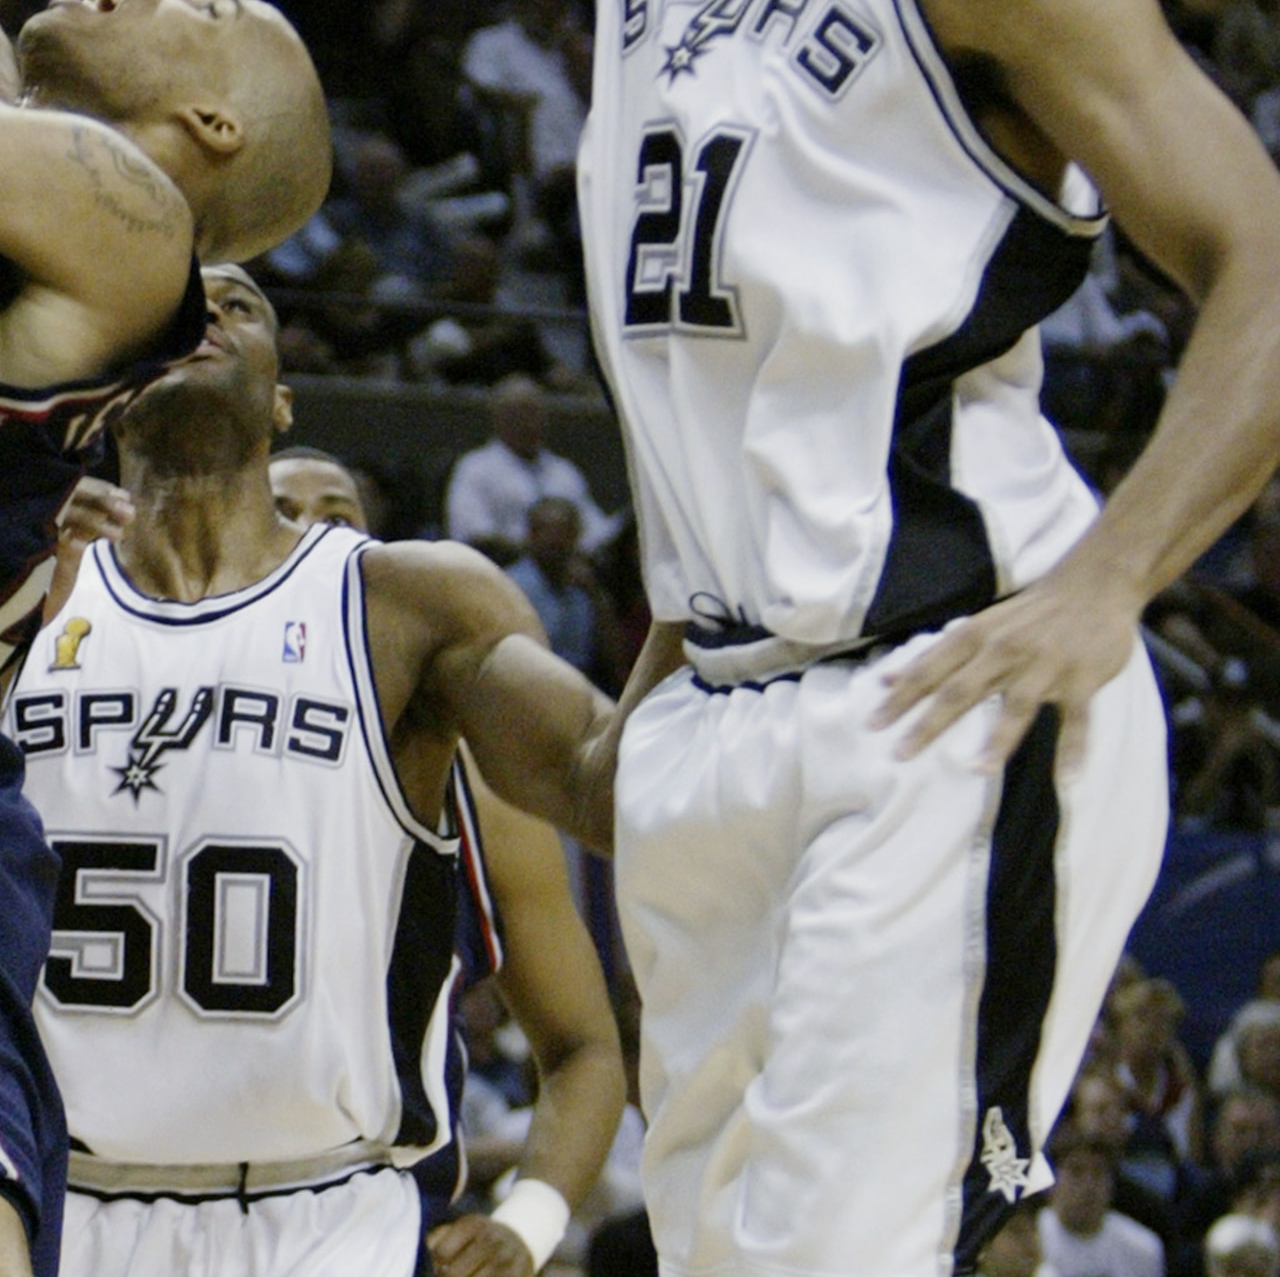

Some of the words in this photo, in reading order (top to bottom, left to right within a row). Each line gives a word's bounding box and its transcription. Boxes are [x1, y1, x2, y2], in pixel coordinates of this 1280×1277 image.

[621, 120, 759, 340] 21
[8, 684, 356, 808] SPURS
[37, 831, 309, 1021] 50
